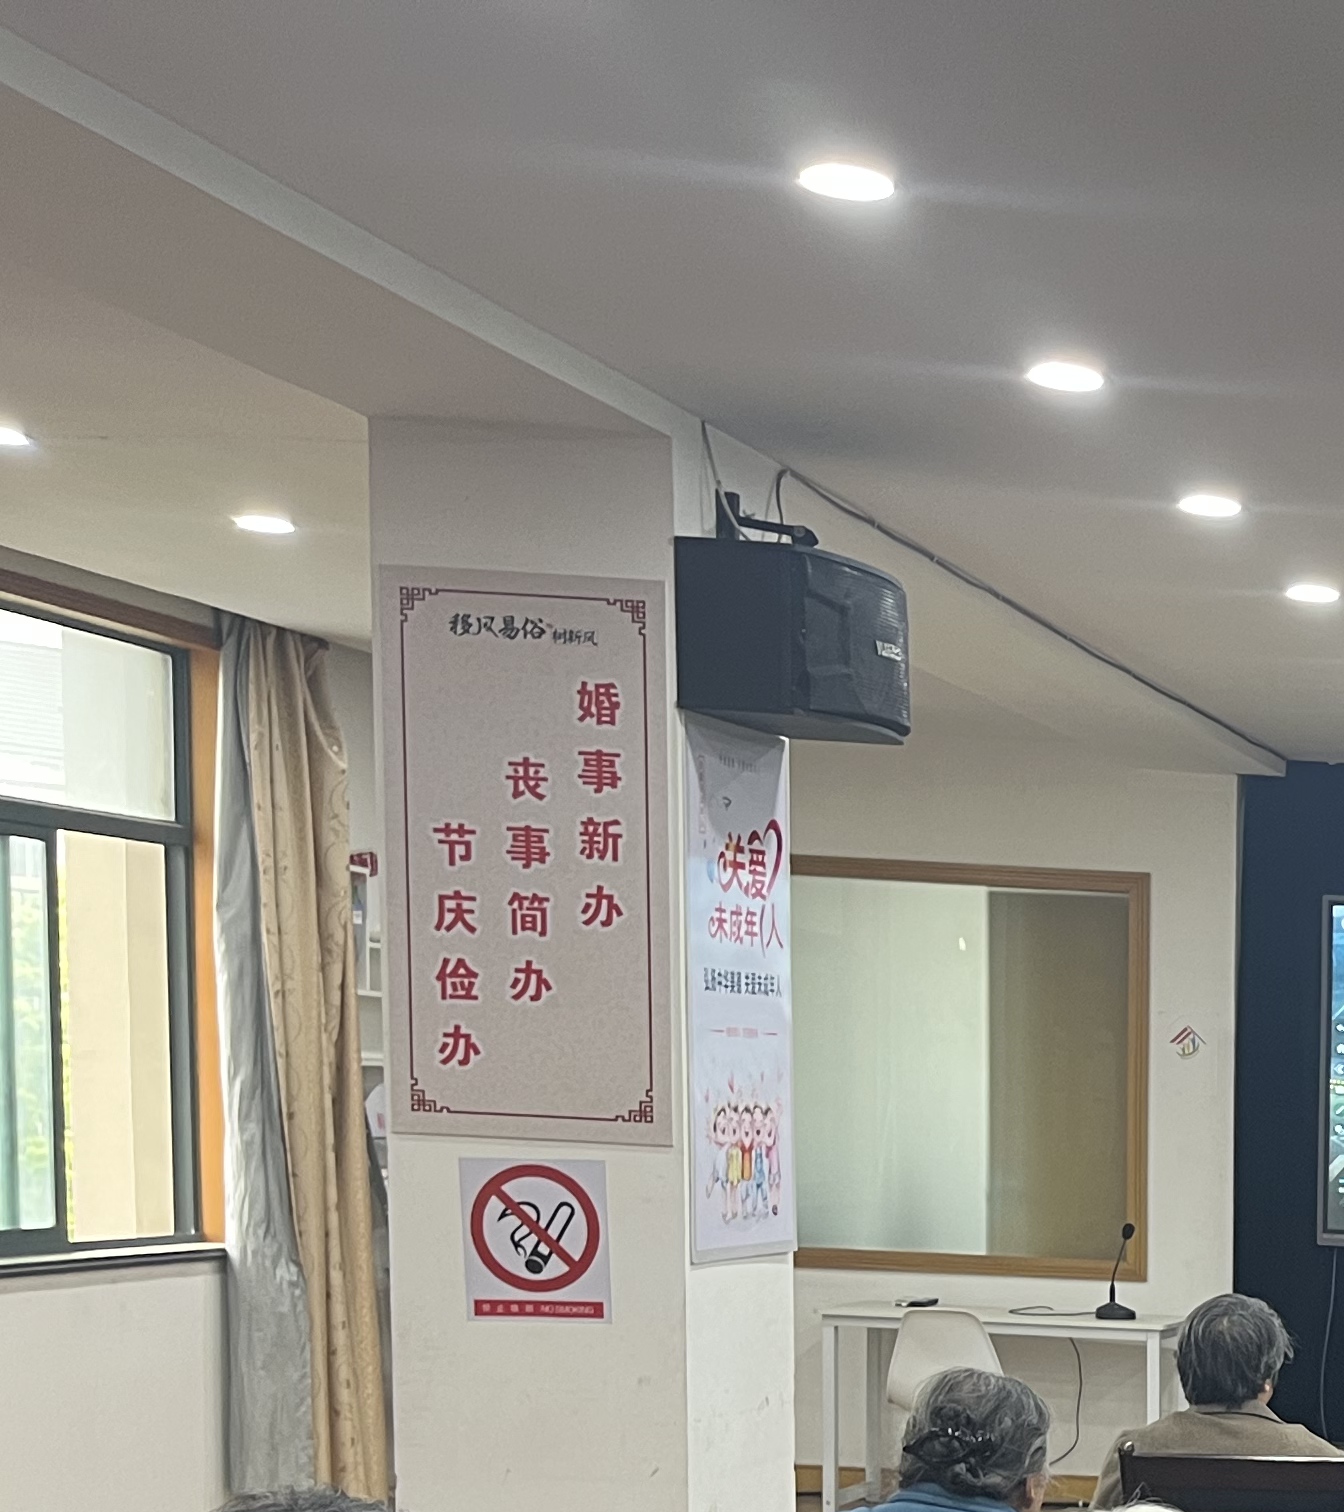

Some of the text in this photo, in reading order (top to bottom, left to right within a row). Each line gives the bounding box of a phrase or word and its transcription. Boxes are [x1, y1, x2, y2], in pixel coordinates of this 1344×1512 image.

[449, 613, 546, 640] 移风易俗
[505, 756, 552, 1002] 丧事简办
[576, 681, 624, 928] 婚事新办
[717, 819, 783, 901] 关爱
[433, 822, 481, 1067] 节庆俭办
[708, 901, 783, 957] 未成年人
